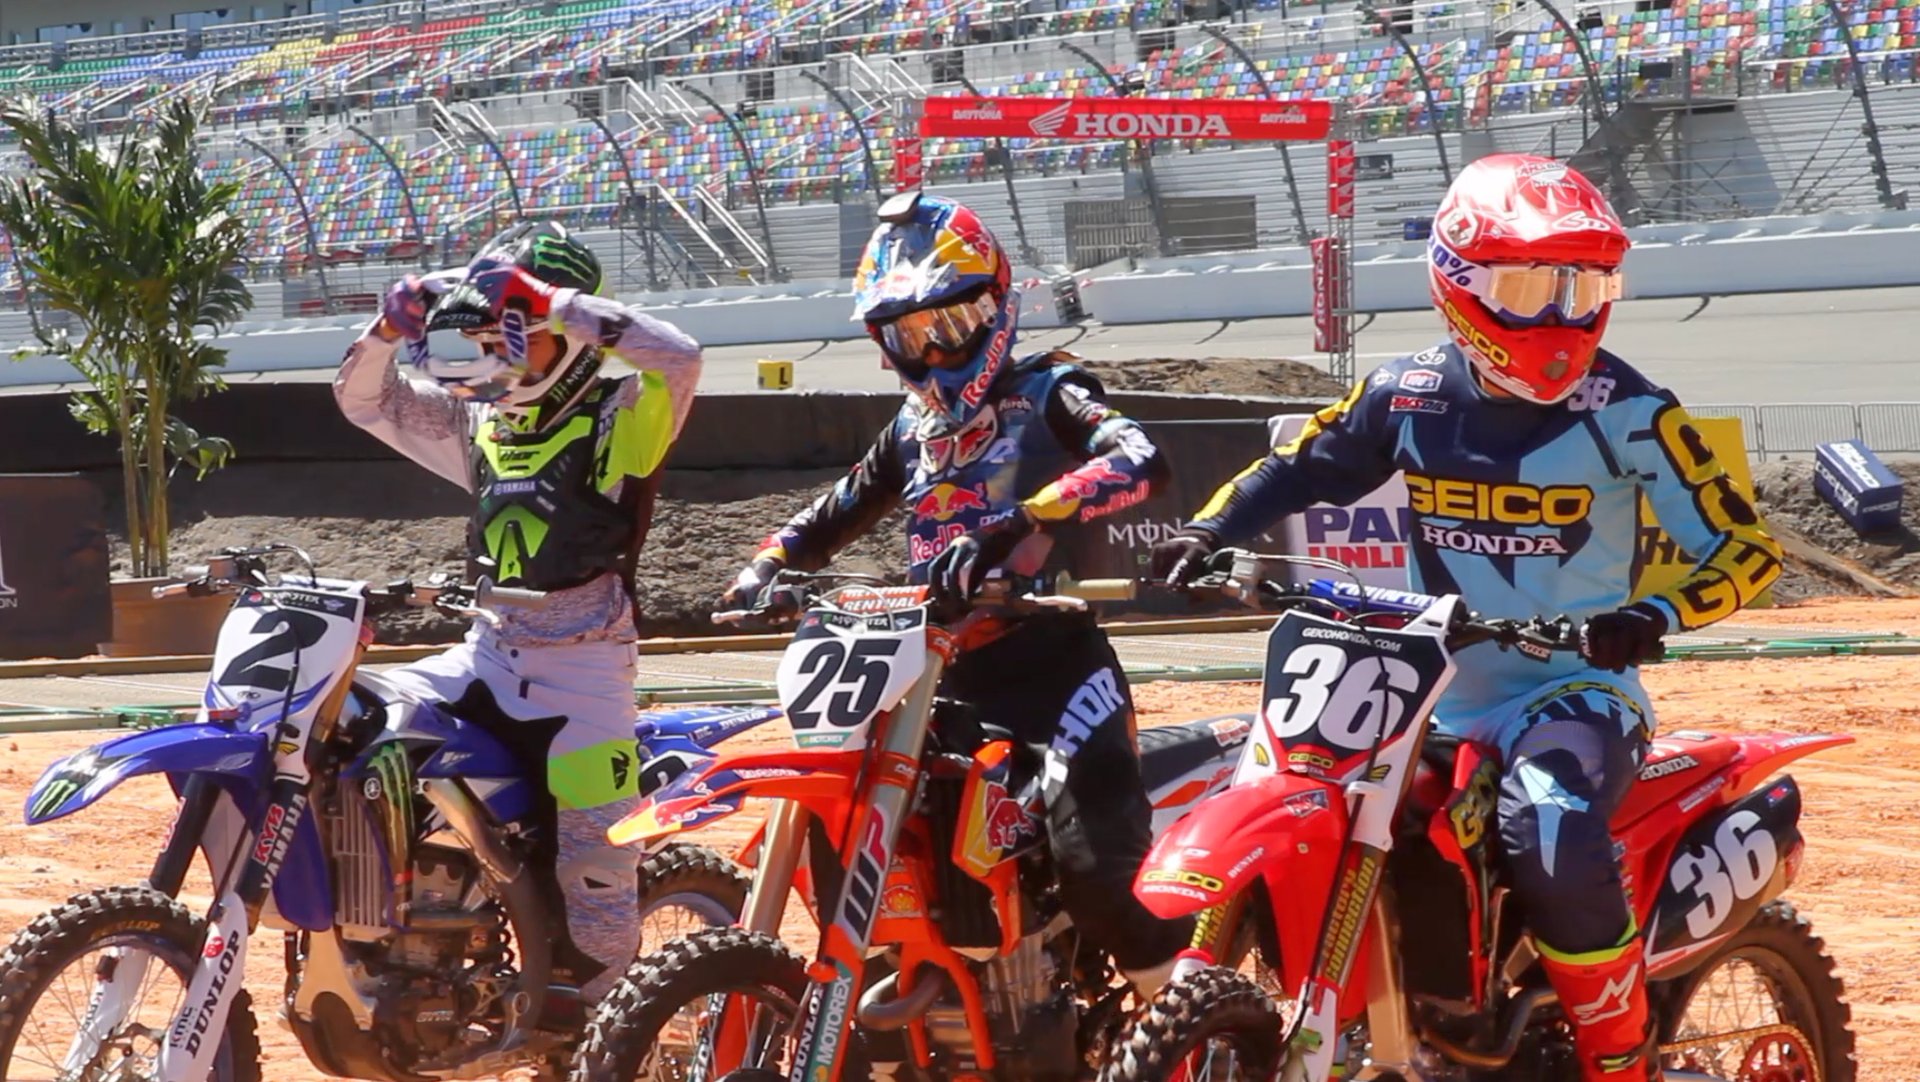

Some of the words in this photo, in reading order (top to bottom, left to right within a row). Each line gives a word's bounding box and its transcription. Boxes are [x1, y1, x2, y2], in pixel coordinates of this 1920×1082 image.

[953, 109, 1002, 120] DAYTONA
[1073, 113, 1231, 137] HONDA
[1259, 113, 1307, 124] DAYTONA
[1444, 300, 1510, 369] GEICO
[1391, 398, 1448, 412] AMSOIL
[501, 481, 536, 493] YAMAHA
[1405, 474, 1595, 526] GEICO
[1420, 523, 1569, 556] HONDA
[217, 609, 329, 692] 2
[786, 638, 903, 730] 25
[1265, 643, 1421, 751] 36
[1288, 752, 1334, 769] GEICO
[252, 803, 285, 865] KYB
[261, 793, 308, 890] YAMAHA
[1142, 868, 1224, 893] GEICO
[1227, 846, 1265, 879] DUNLOP
[1670, 809, 1778, 939] 36
[1140, 884, 1209, 902] HONDA
[185, 930, 241, 1059] DUNLOP
[815, 975, 853, 1066] MOTOREX
